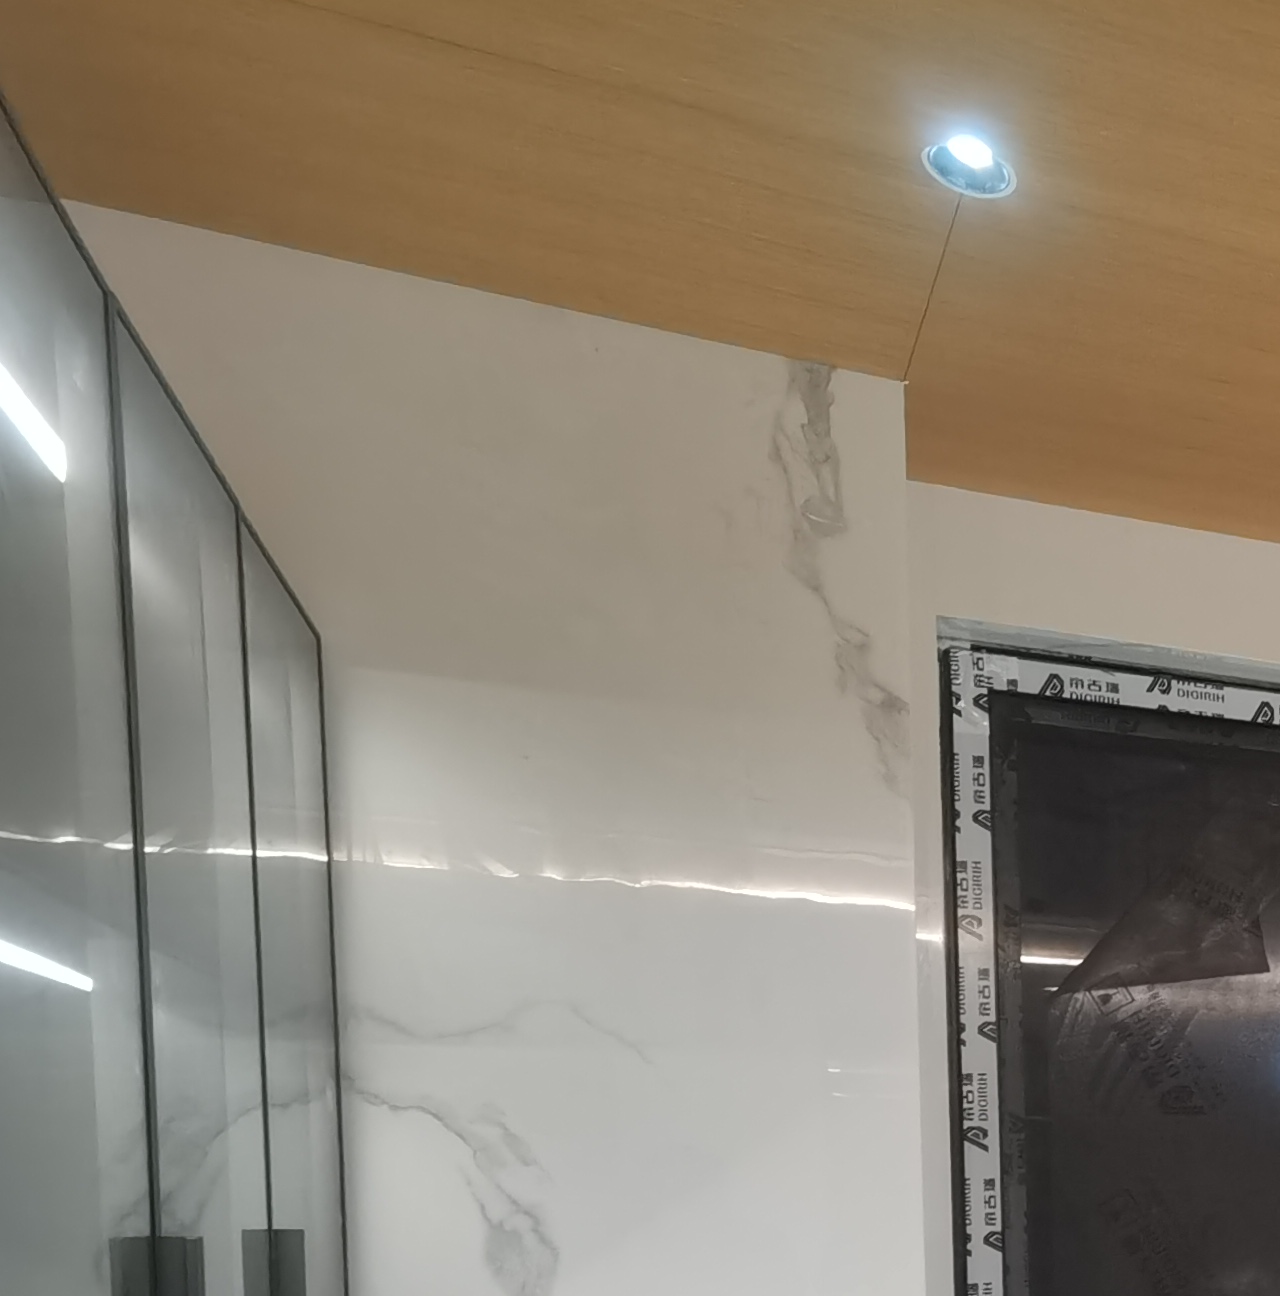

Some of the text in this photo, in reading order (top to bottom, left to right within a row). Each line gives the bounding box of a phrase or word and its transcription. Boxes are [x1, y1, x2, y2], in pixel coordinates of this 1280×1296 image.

[1177, 688, 1225, 703] DIGIRIH
[971, 860, 983, 910] DIGIRIH
[977, 1073, 989, 1122] DIGIRIH
